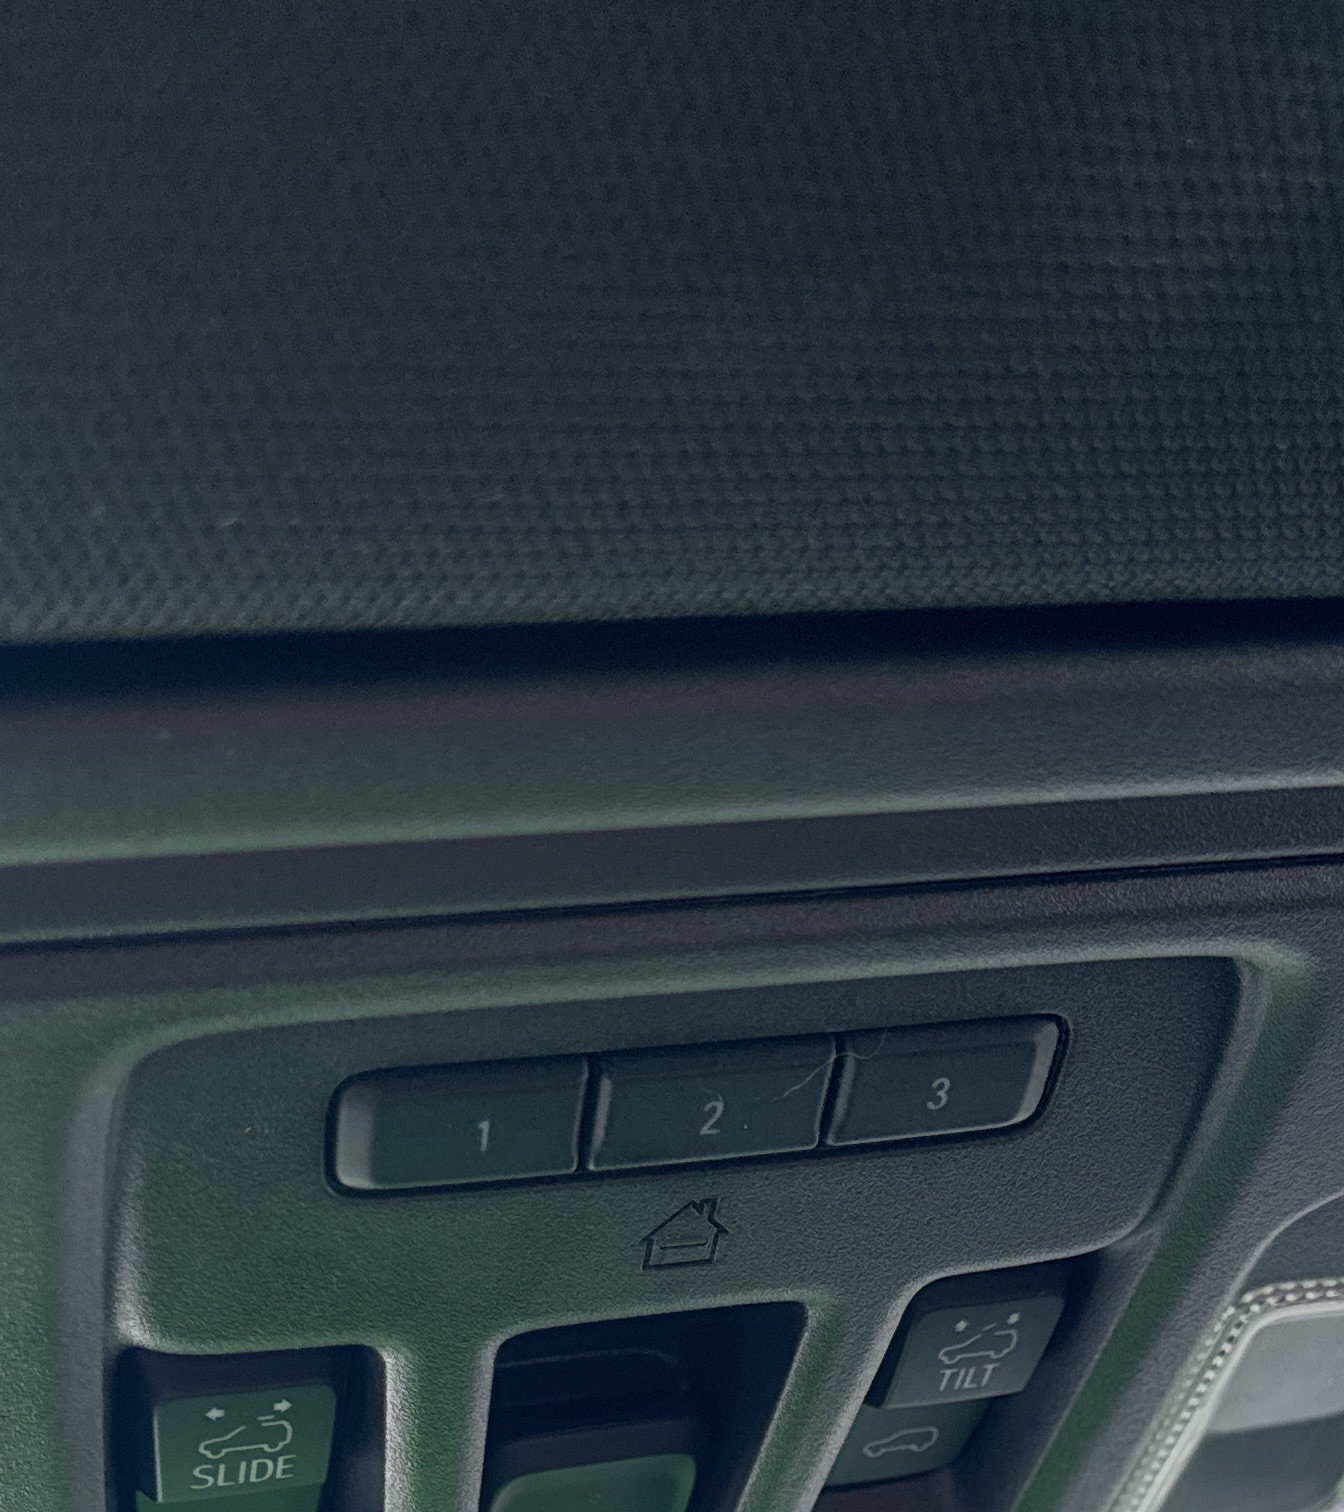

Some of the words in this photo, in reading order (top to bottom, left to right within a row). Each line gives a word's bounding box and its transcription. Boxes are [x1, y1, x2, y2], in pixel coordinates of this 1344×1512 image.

[925, 1076, 951, 1111] 3
[699, 1100, 725, 1135] 2
[477, 1119, 491, 1153] 1
[938, 1362, 1001, 1392] TILT
[189, 1453, 297, 1490] SLIDE
